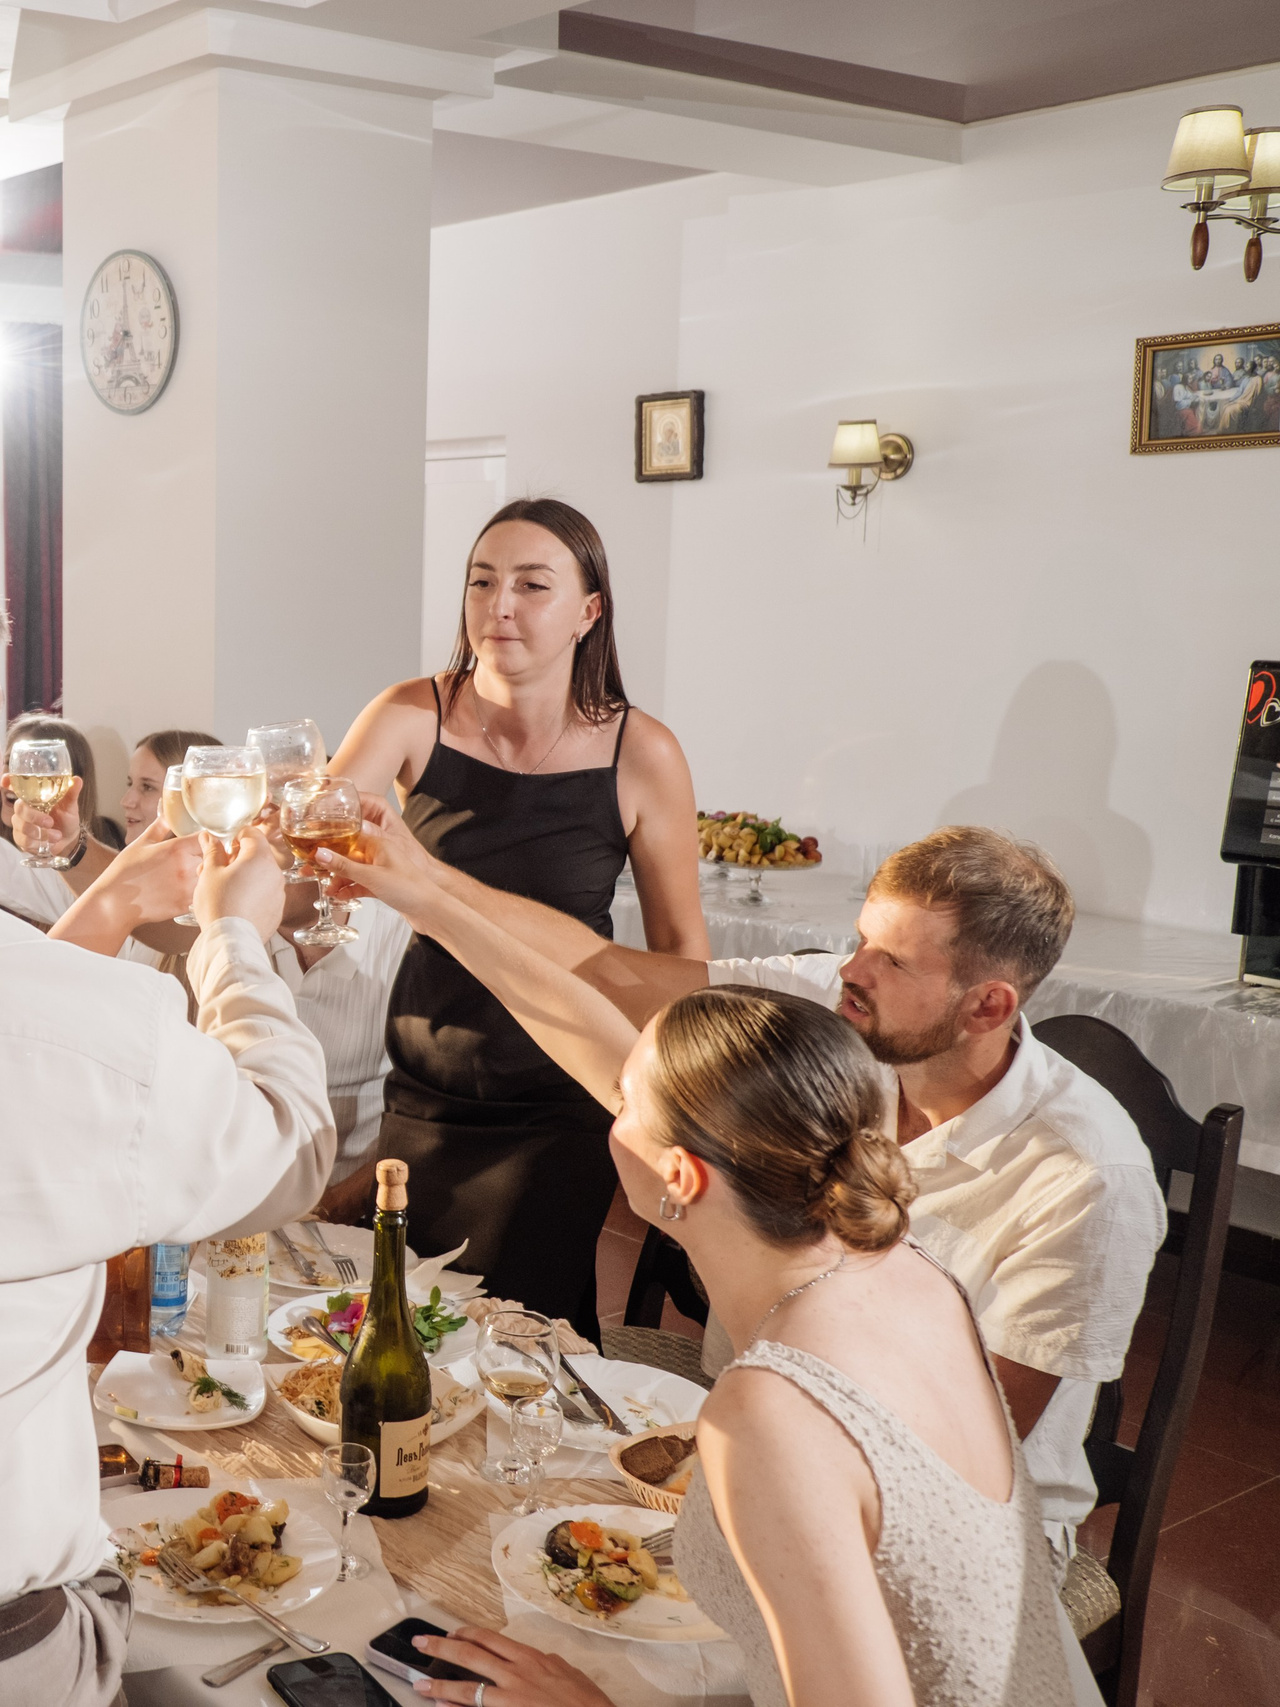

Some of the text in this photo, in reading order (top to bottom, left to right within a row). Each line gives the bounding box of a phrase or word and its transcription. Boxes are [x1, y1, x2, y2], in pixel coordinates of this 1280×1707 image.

[119, 258, 131, 282] 12
[100, 273, 109, 294] 11
[152, 287, 161, 310] 2
[89, 298, 100, 320] 10
[86, 328, 95, 348] 9
[158, 317, 168, 340] 3
[92, 357, 101, 376] 8
[152, 349, 162, 369] 4
[142, 375, 150, 395] 5
[124, 386, 132, 405] 6
